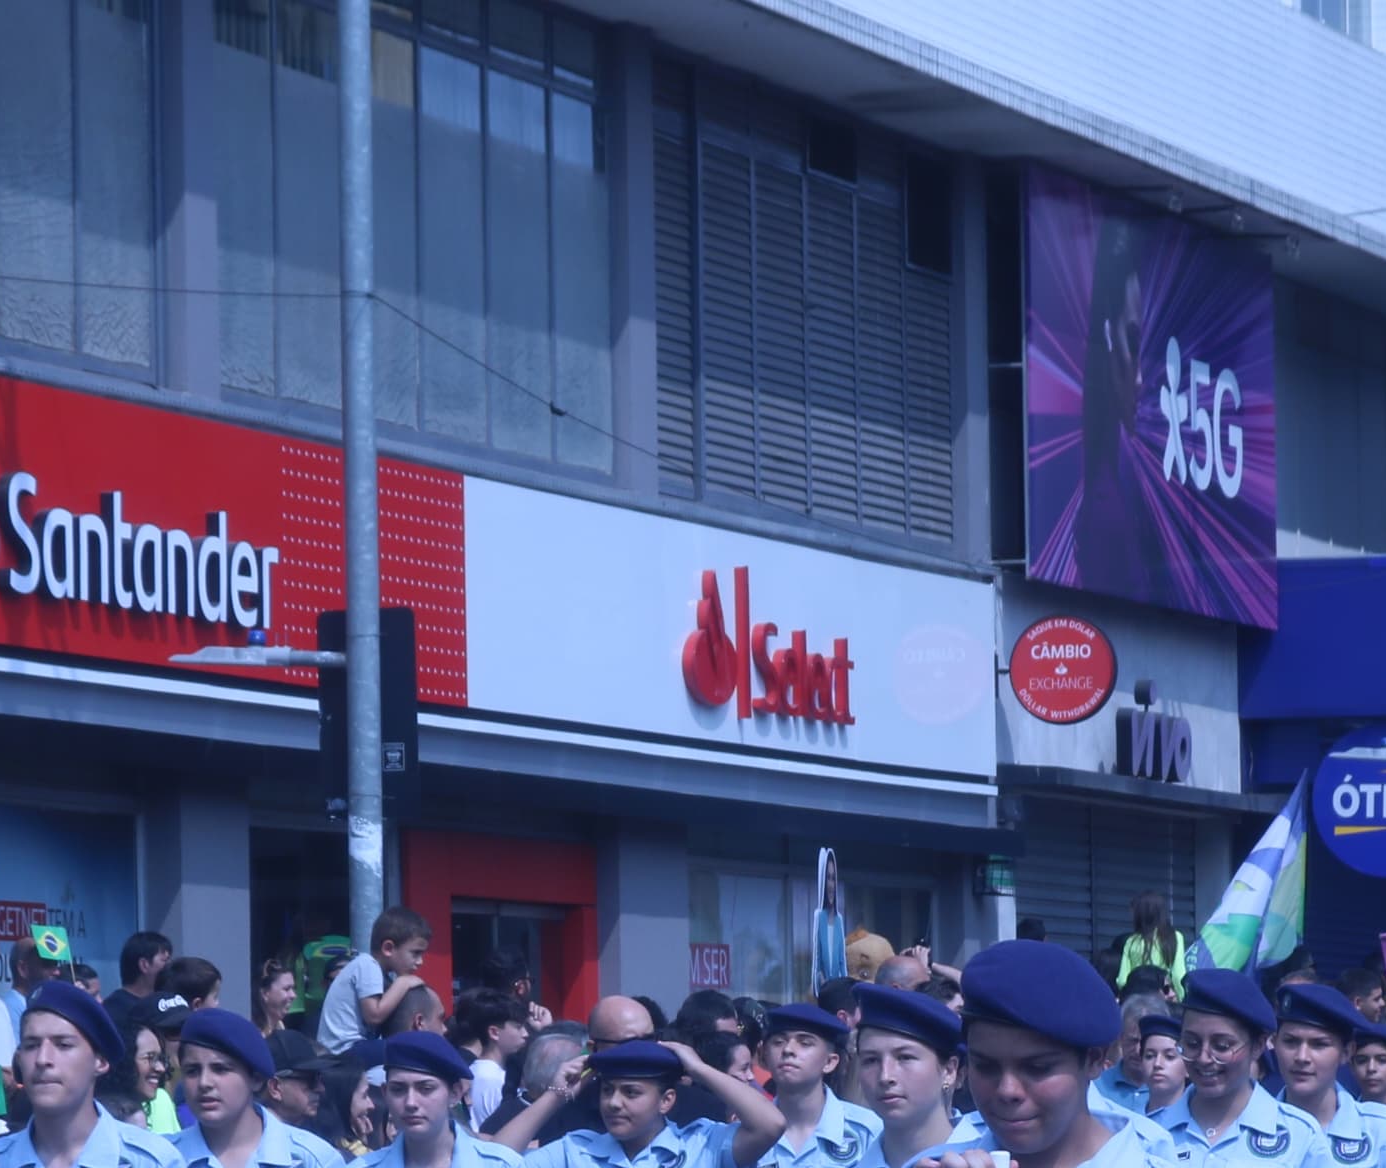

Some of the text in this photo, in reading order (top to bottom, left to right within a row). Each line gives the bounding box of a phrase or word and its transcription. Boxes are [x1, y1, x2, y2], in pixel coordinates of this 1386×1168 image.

[1188, 358, 1244, 499] 5G
[0, 471, 280, 629] Santander
[1026, 621, 1054, 642] SAQUE
[1054, 618, 1068, 629] EM
[1030, 641, 1092, 660] CÂMBIO
[1028, 676, 1094, 691] EXCHANGE
[1018, 687, 1106, 720] DOLLAR WITHDRAWAL
[703, 948, 729, 985] SER
